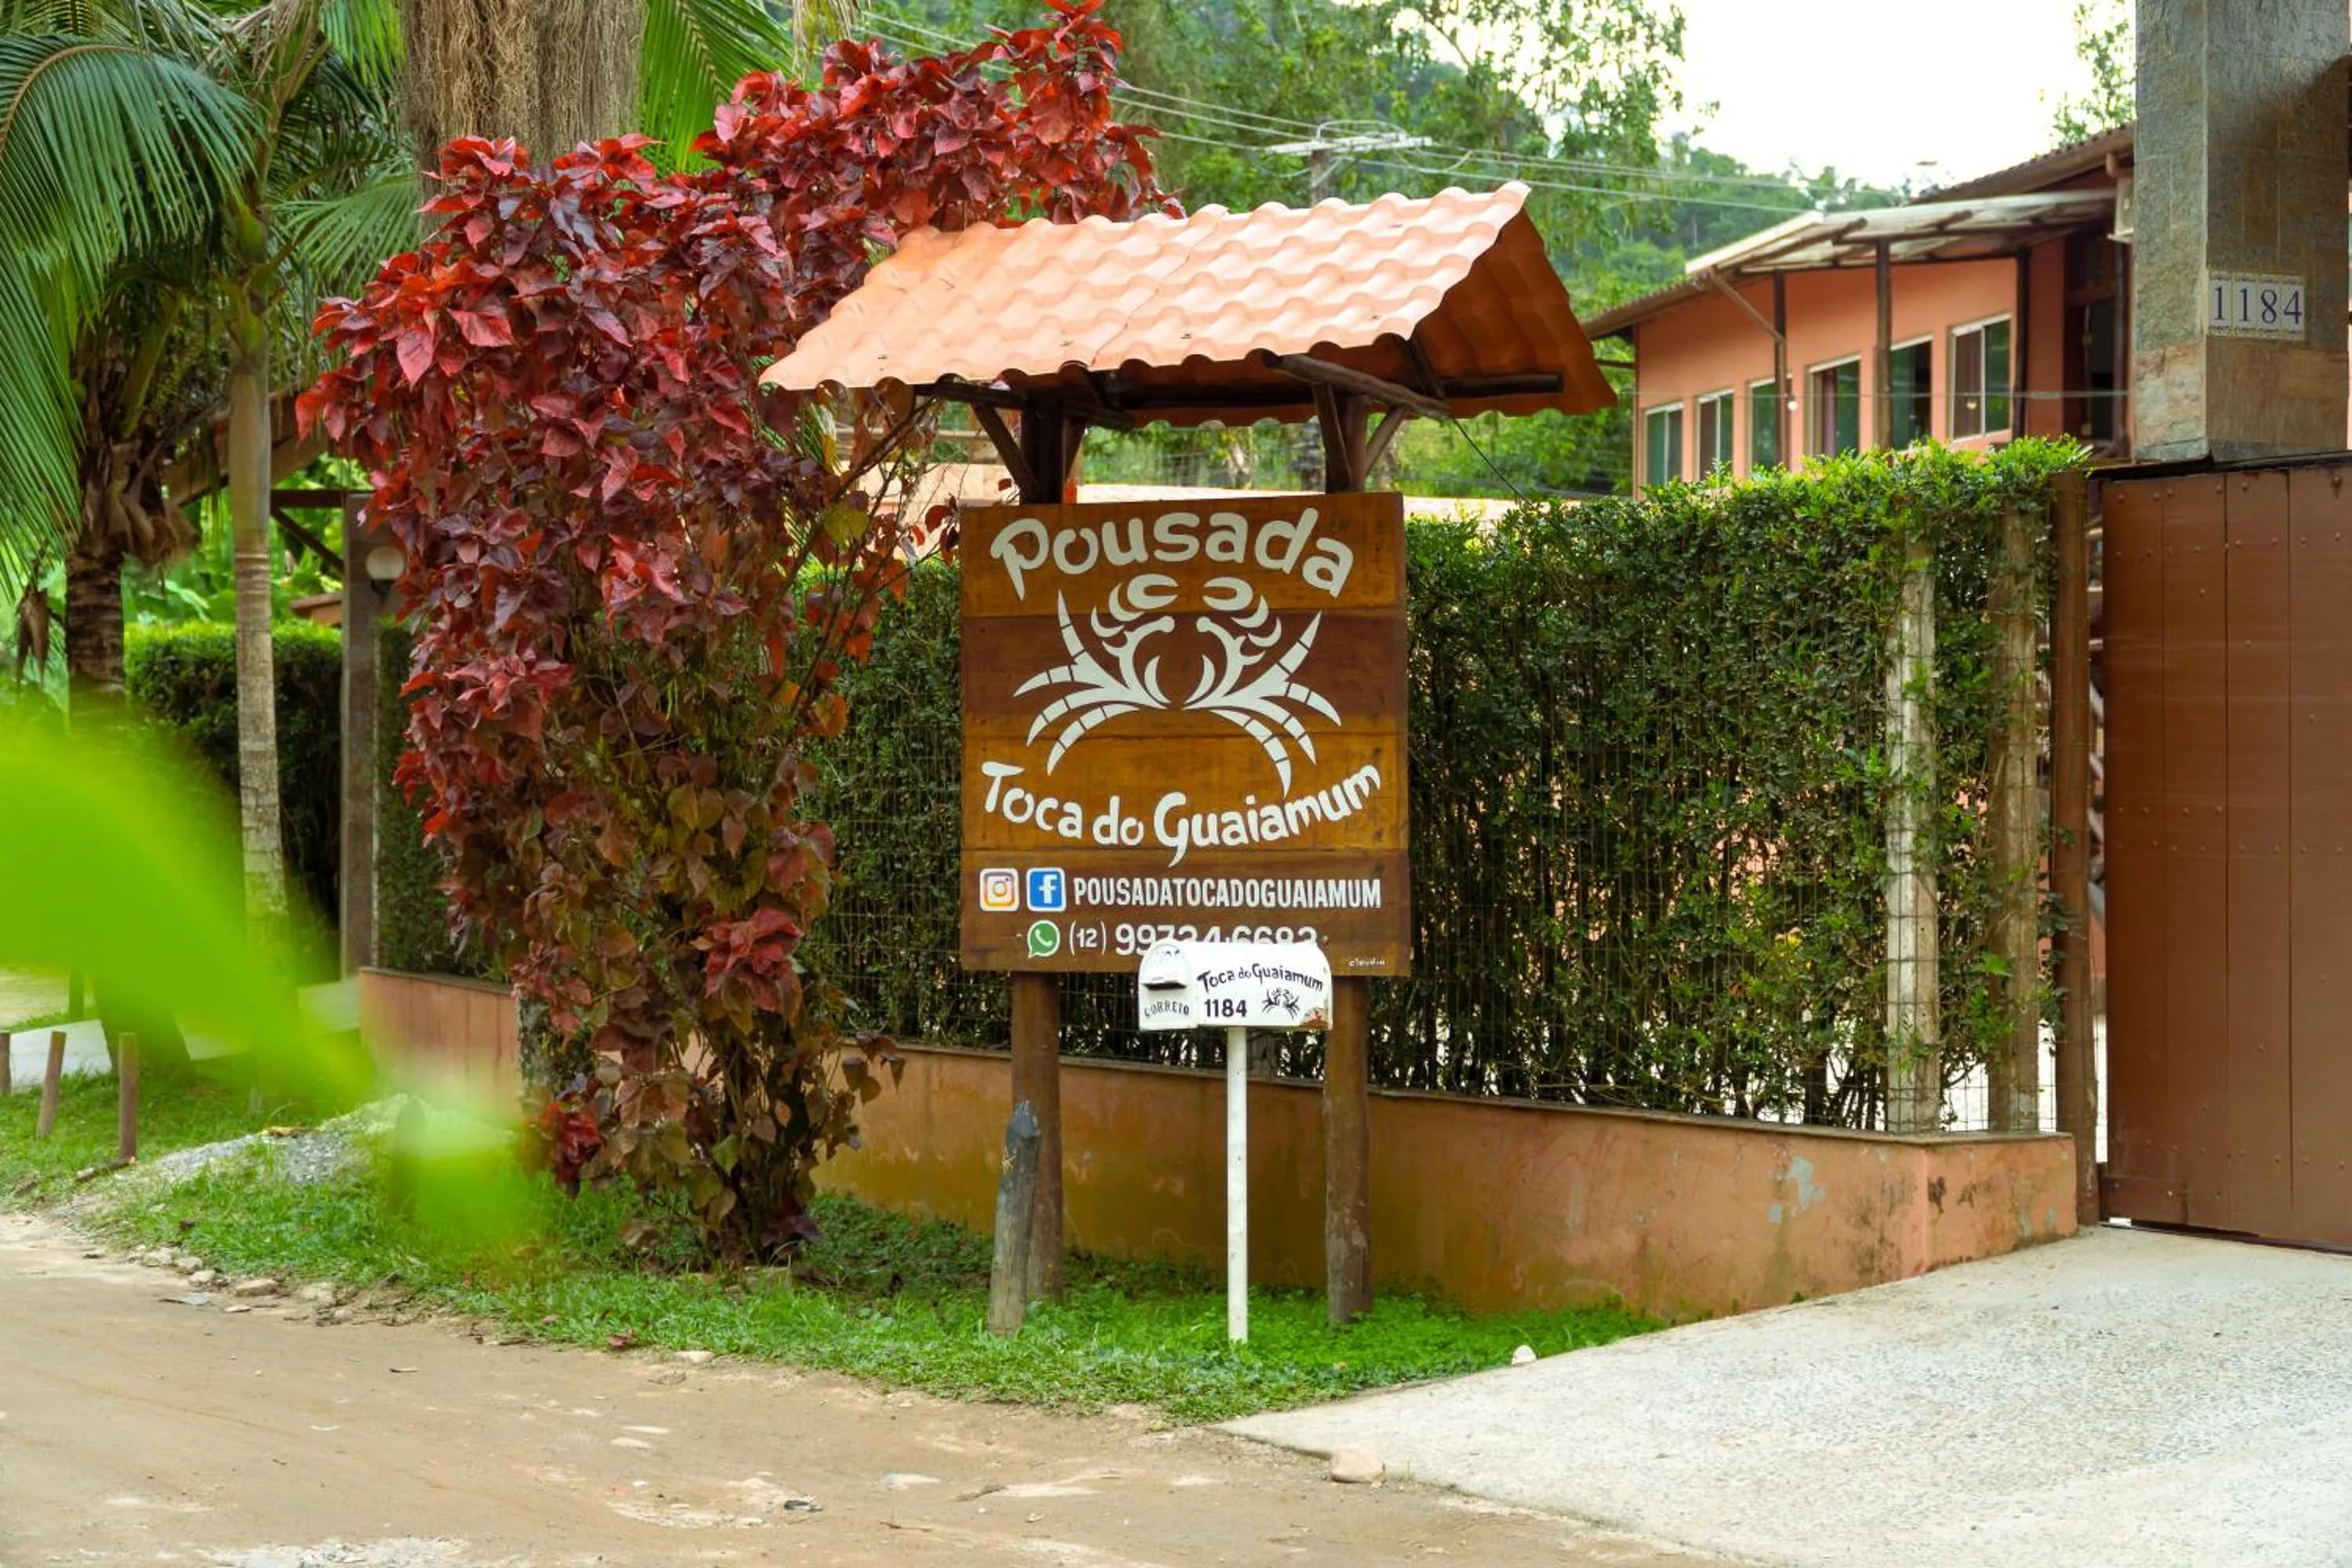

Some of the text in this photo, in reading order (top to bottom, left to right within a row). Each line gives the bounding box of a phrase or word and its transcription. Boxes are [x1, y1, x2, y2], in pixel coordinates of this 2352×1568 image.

[2213, 285, 2303, 325] 1184
[990, 507, 1354, 601] Pousada
[981, 760, 1381, 868] Toca do Guaiamum
[1073, 877, 1381, 909] POUSADATOCADOGUAIAMUM
[1069, 920, 1107, 956] (12)
[1196, 963, 1323, 994] Toca do Guaiamum
[1203, 998, 1247, 1018] 1184
